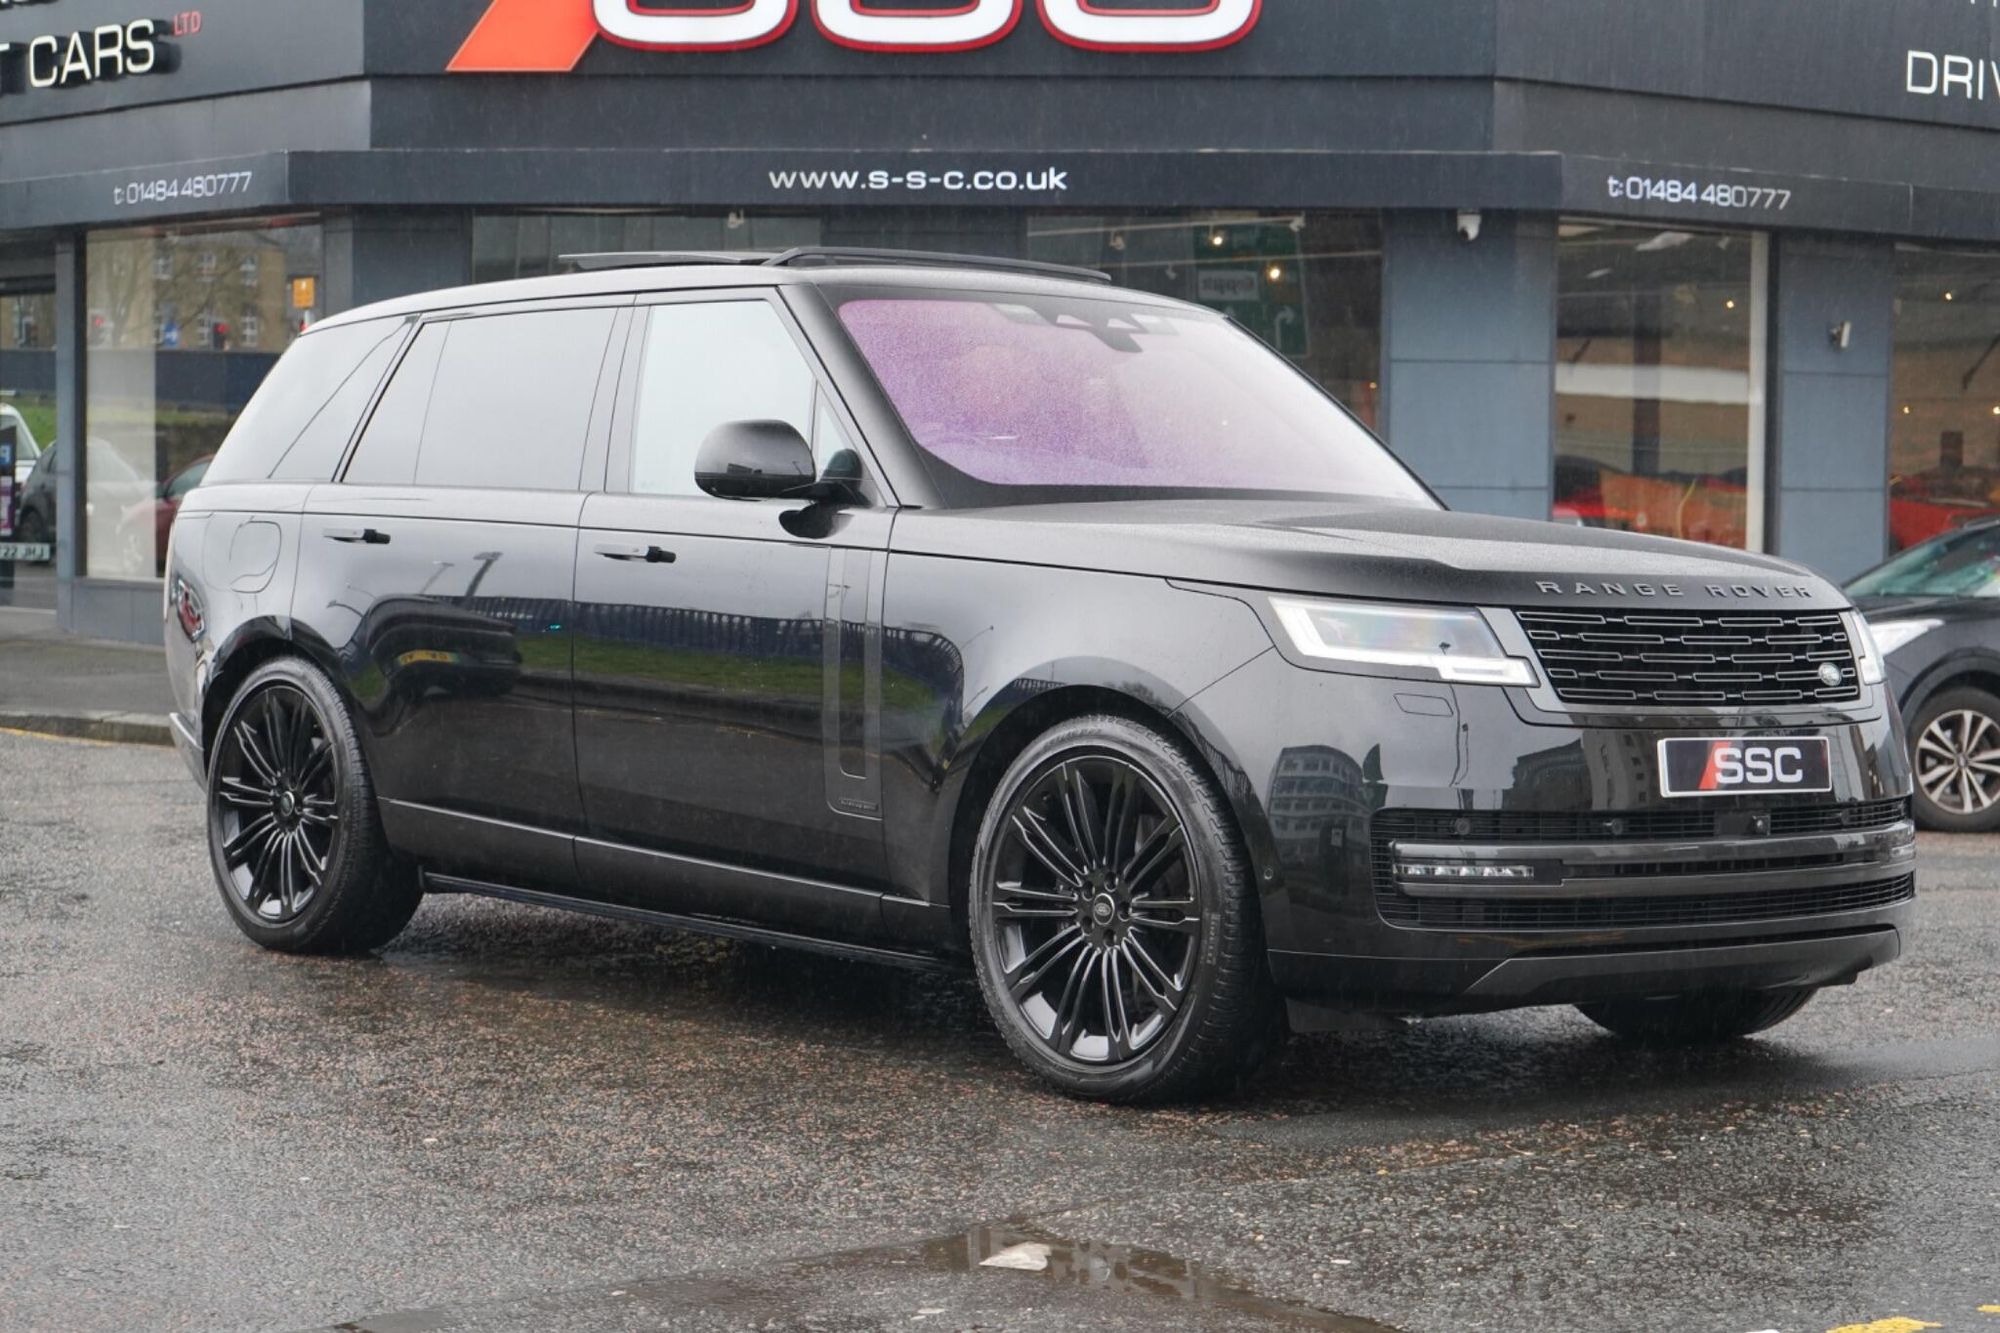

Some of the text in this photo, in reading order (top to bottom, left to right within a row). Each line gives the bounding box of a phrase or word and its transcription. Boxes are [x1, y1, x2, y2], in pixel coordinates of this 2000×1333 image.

[29, 11, 202, 88] CARS LTD
[768, 167, 1068, 191] www.s-s-c.co.uk
[1700, 183, 1792, 210] 480777
[1535, 580, 1813, 598] RANGE ROVER
[1714, 747, 1803, 784] SSC
